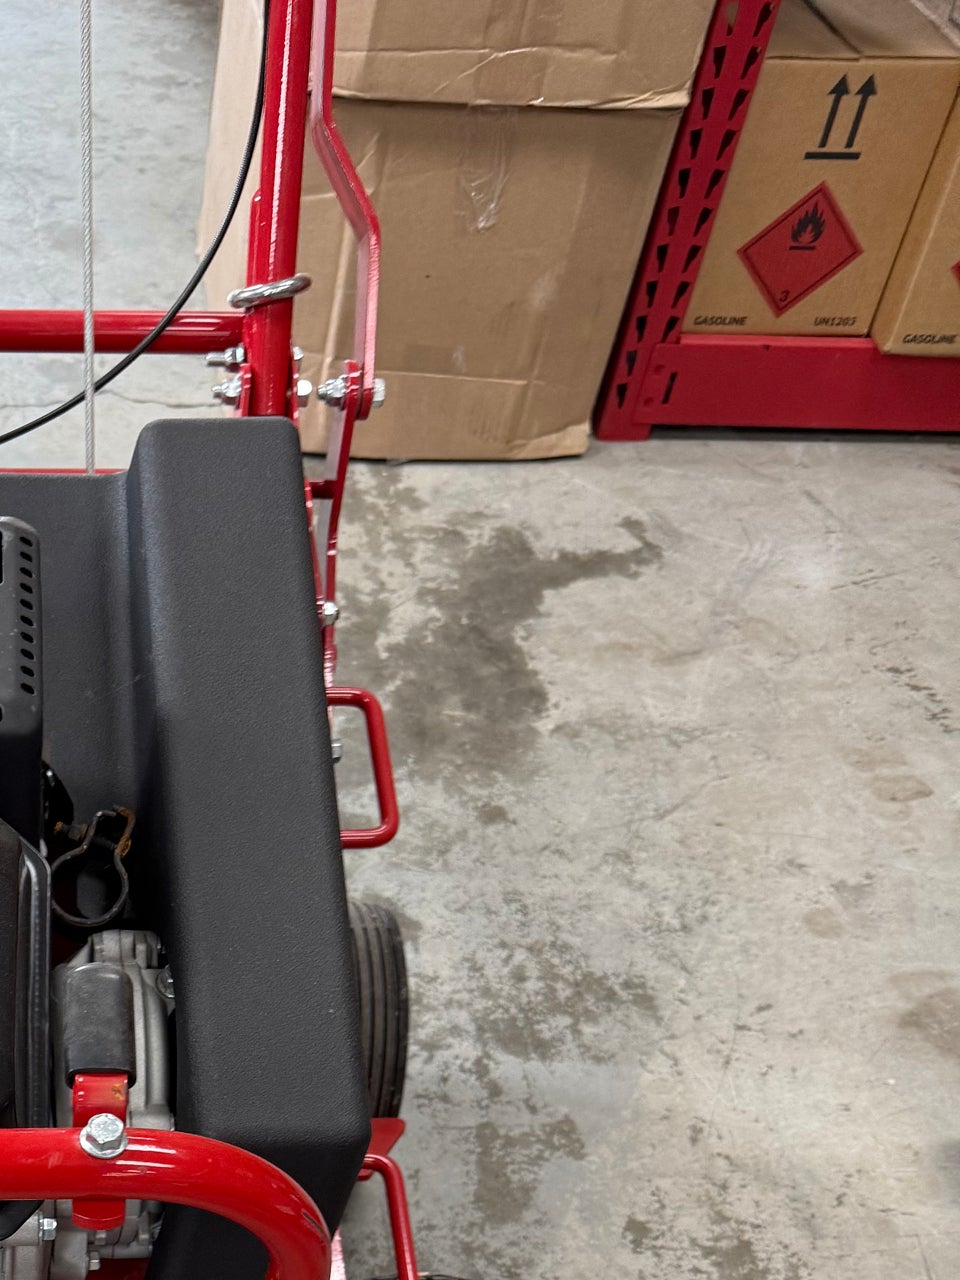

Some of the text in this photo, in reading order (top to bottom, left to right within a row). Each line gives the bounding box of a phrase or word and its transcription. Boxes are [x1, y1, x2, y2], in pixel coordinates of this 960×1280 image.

[779, 289, 789, 301] 3
[693, 315, 748, 326] GASOLINE
[902, 333, 958, 345] GASOLINE
